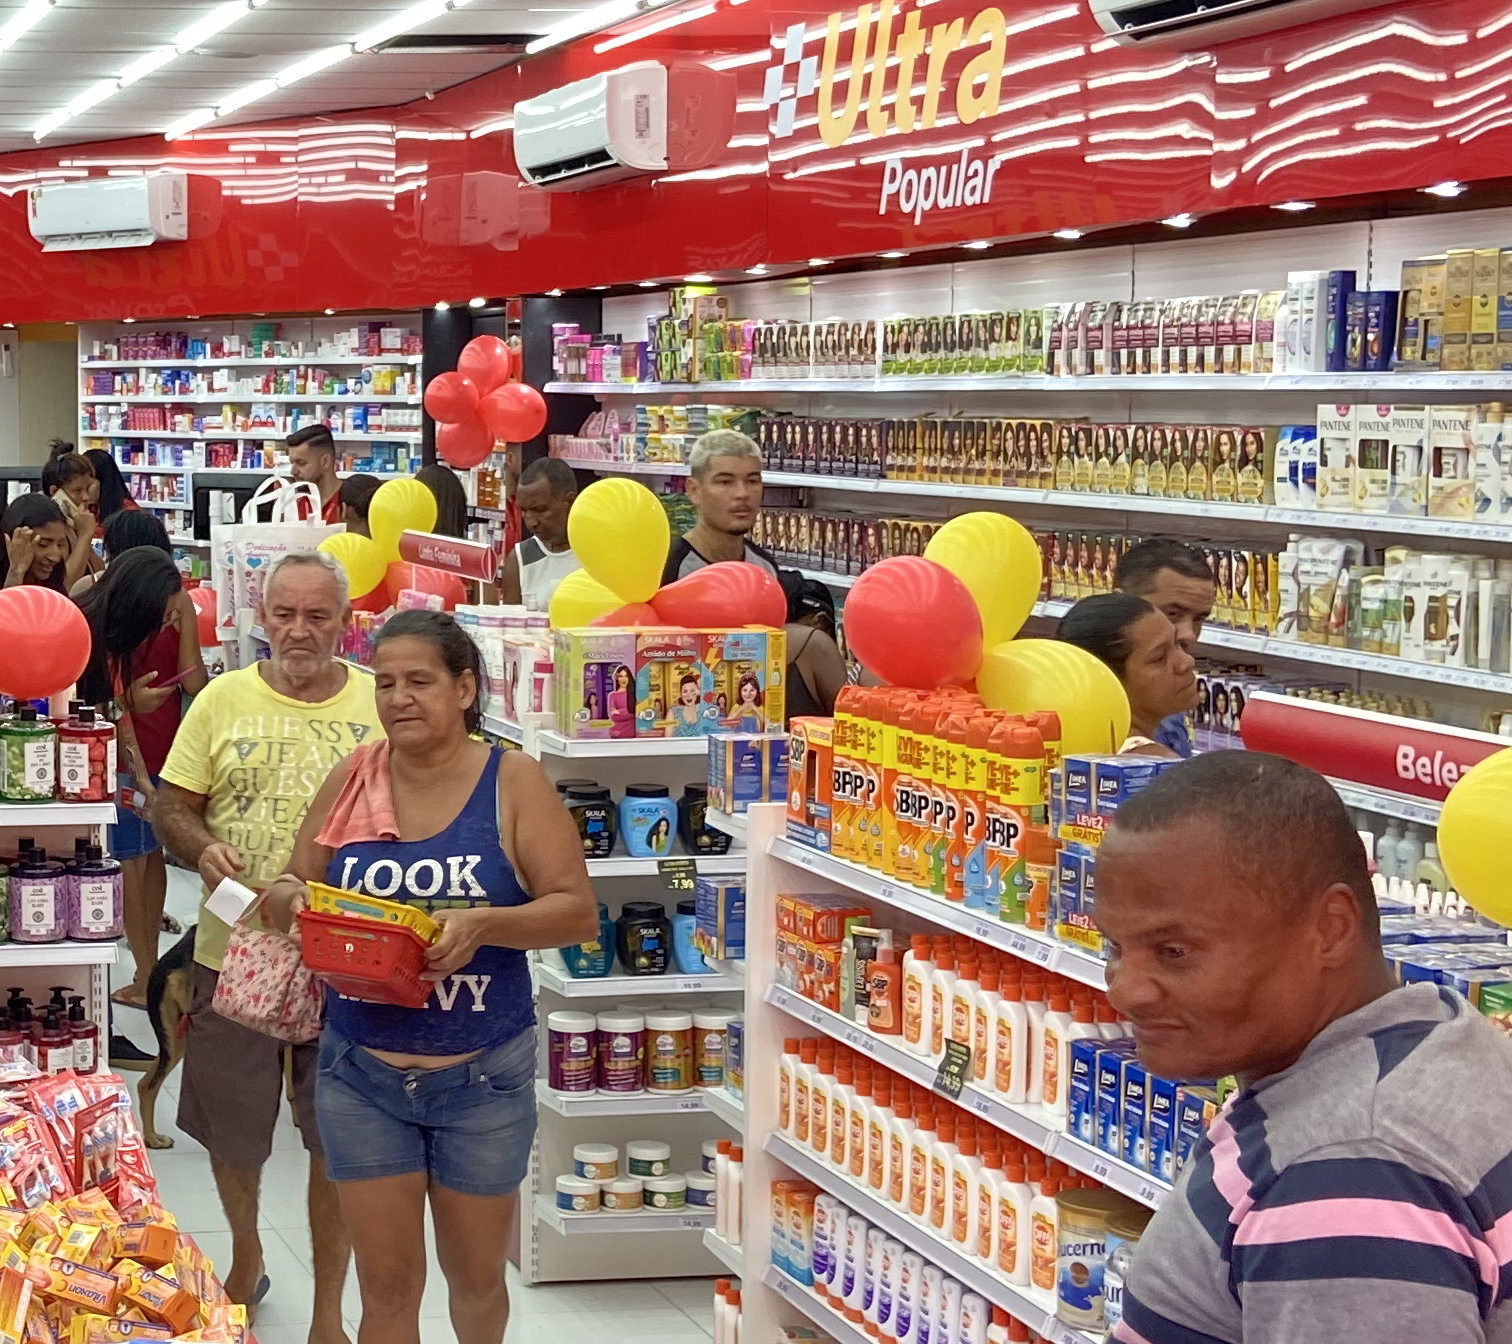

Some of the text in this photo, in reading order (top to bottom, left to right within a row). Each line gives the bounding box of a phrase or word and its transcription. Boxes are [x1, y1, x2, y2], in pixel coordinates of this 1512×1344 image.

[879, 148, 1002, 225] Popular
[1320, 420, 1352, 432] PANTENE
[1359, 421, 1390, 432] PANTENE
[1392, 418, 1426, 429] PANTENE
[1432, 419, 1471, 431] PANTENE
[232, 715, 343, 743] GUESS
[791, 737, 805, 762] SBP
[228, 767, 327, 797] GUES
[1068, 772, 1087, 787] LINEA
[1099, 777, 1118, 793] LINEA
[585, 810, 606, 818] SKALA
[227, 822, 298, 853] GUE
[341, 854, 487, 898] LOOK
[640, 928, 661, 936] SKALA
[1073, 1058, 1089, 1073] LINEA
[1100, 1069, 1116, 1085] LINEA
[1127, 1081, 1144, 1097] LINEA
[1154, 1093, 1170, 1109] LINEA
[1184, 1106, 1199, 1122] LINEA
